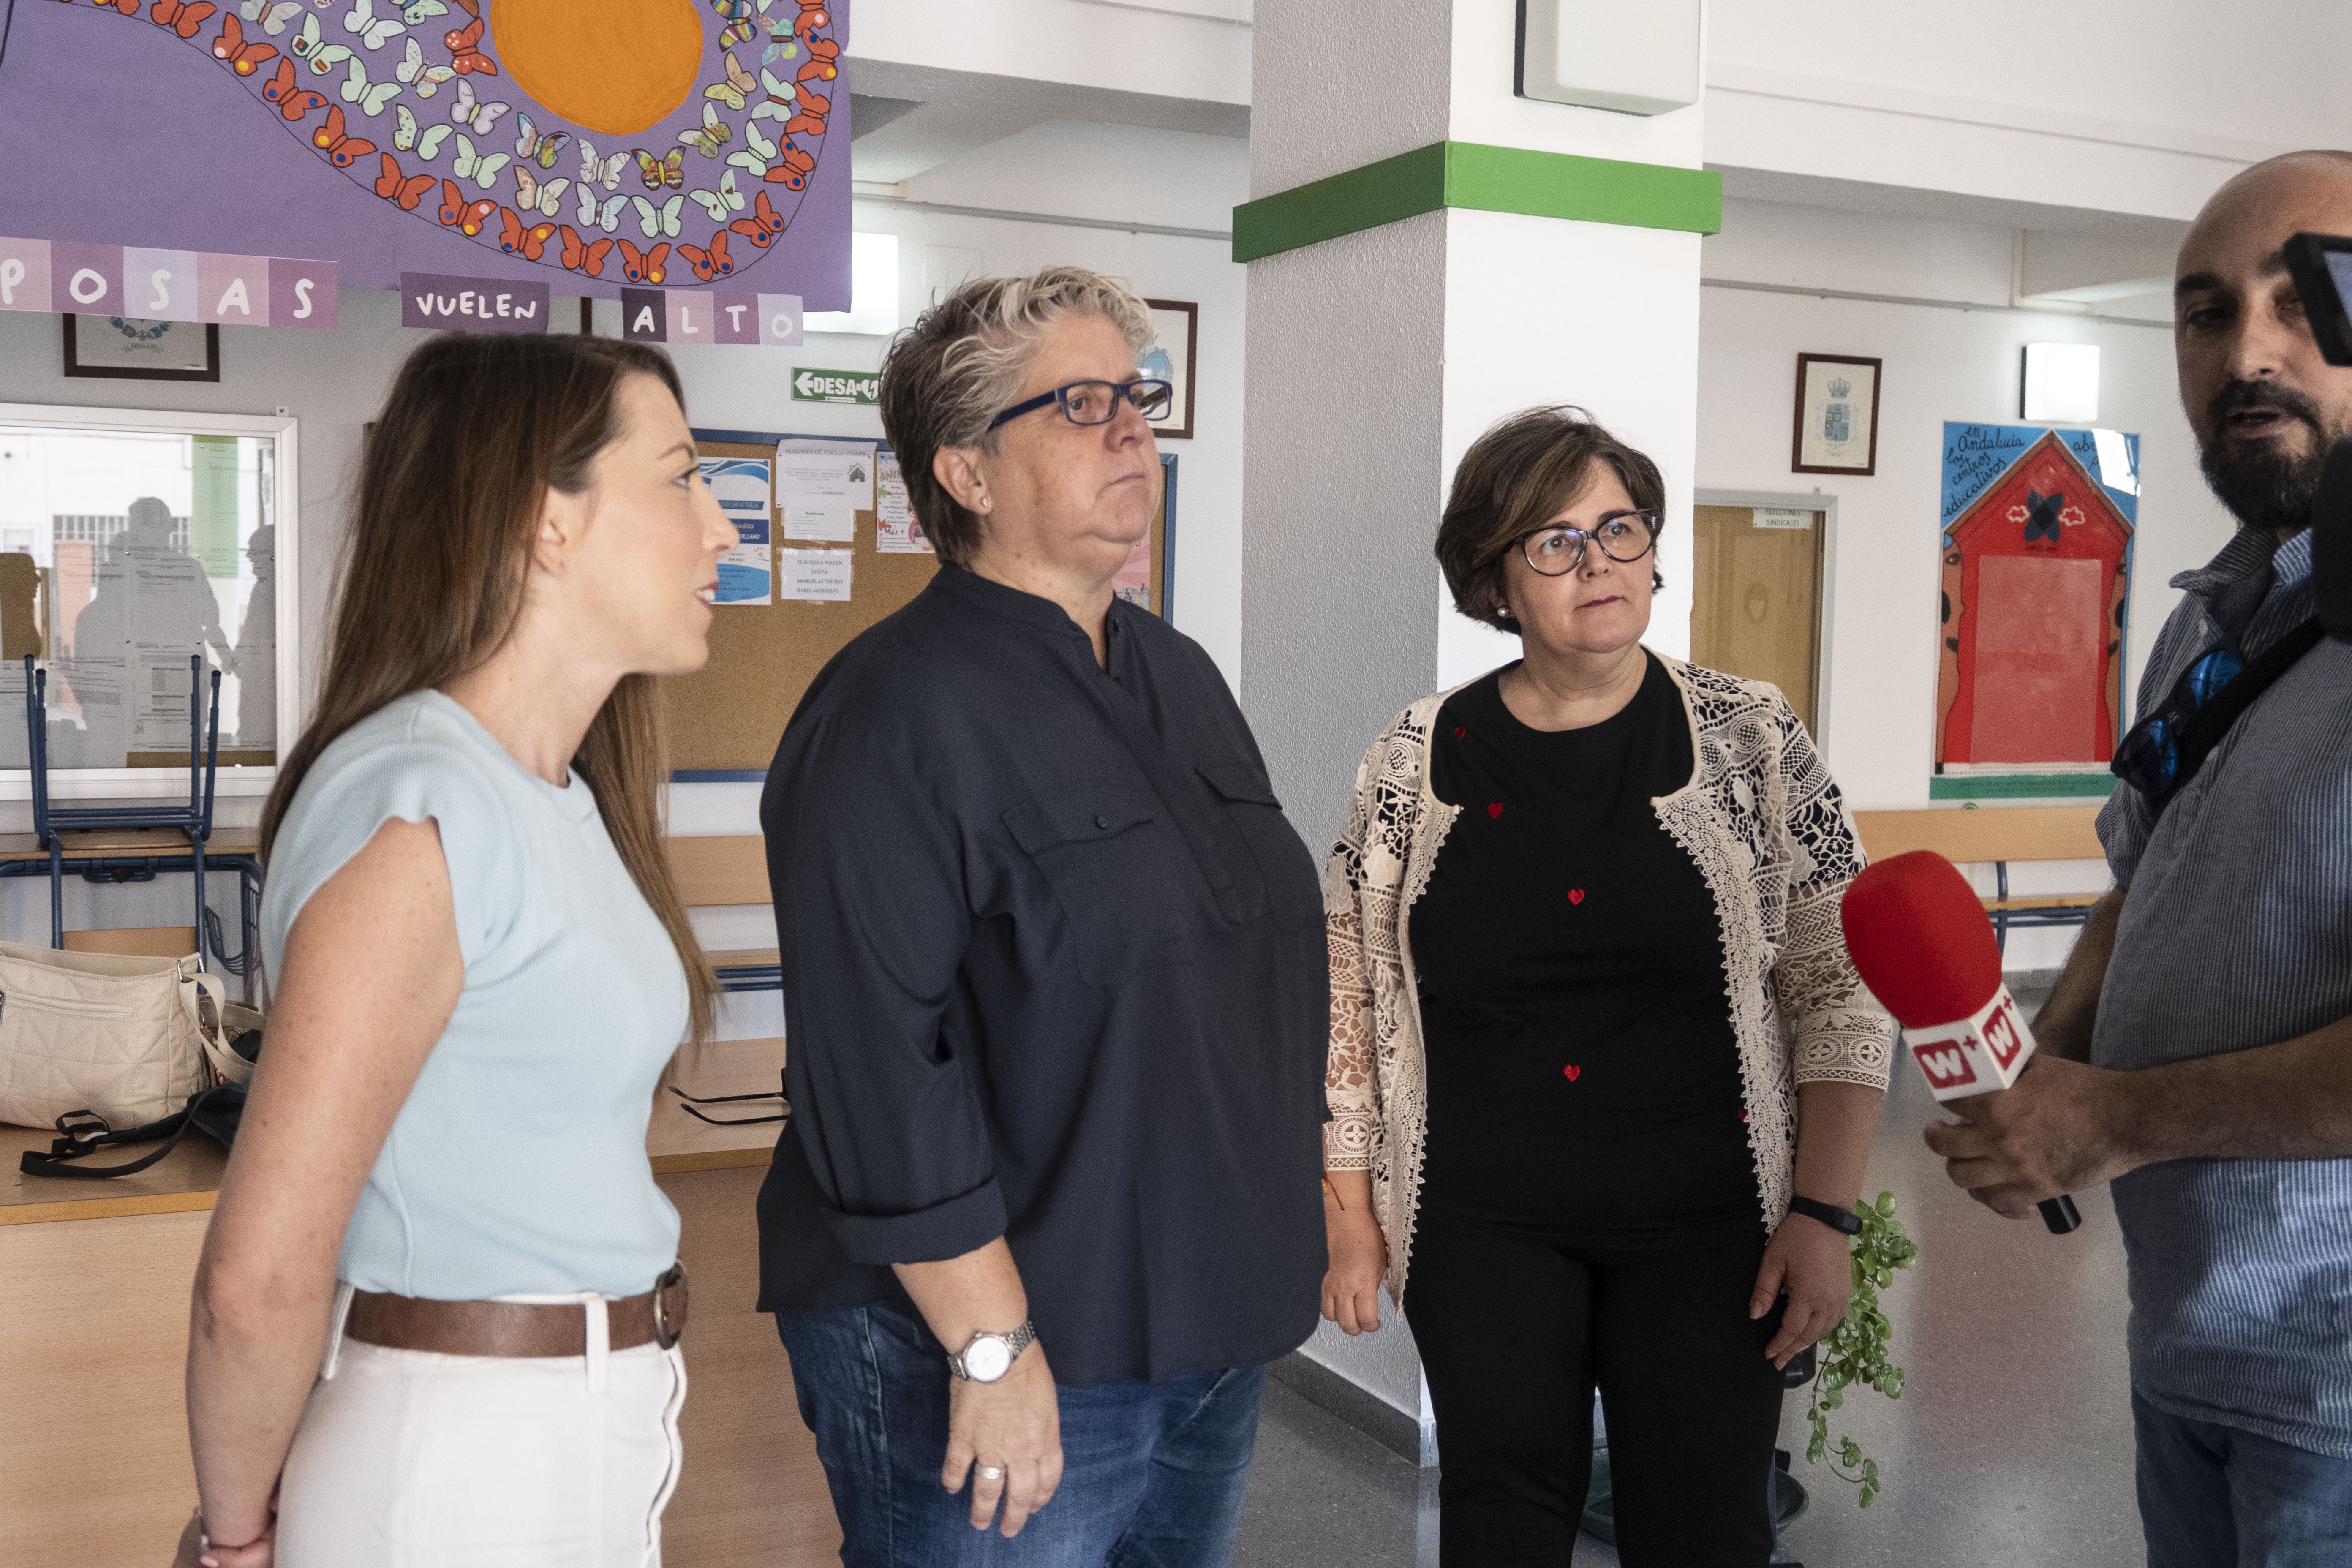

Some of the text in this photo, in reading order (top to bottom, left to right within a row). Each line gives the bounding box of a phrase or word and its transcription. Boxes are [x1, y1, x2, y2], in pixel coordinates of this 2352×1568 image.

[416, 291, 536, 320] VUELEN
[633, 305, 793, 339] ALTO
[1947, 447, 1965, 468] los
[1953, 452, 1991, 485] centros
[1943, 457, 2006, 517] educativos
